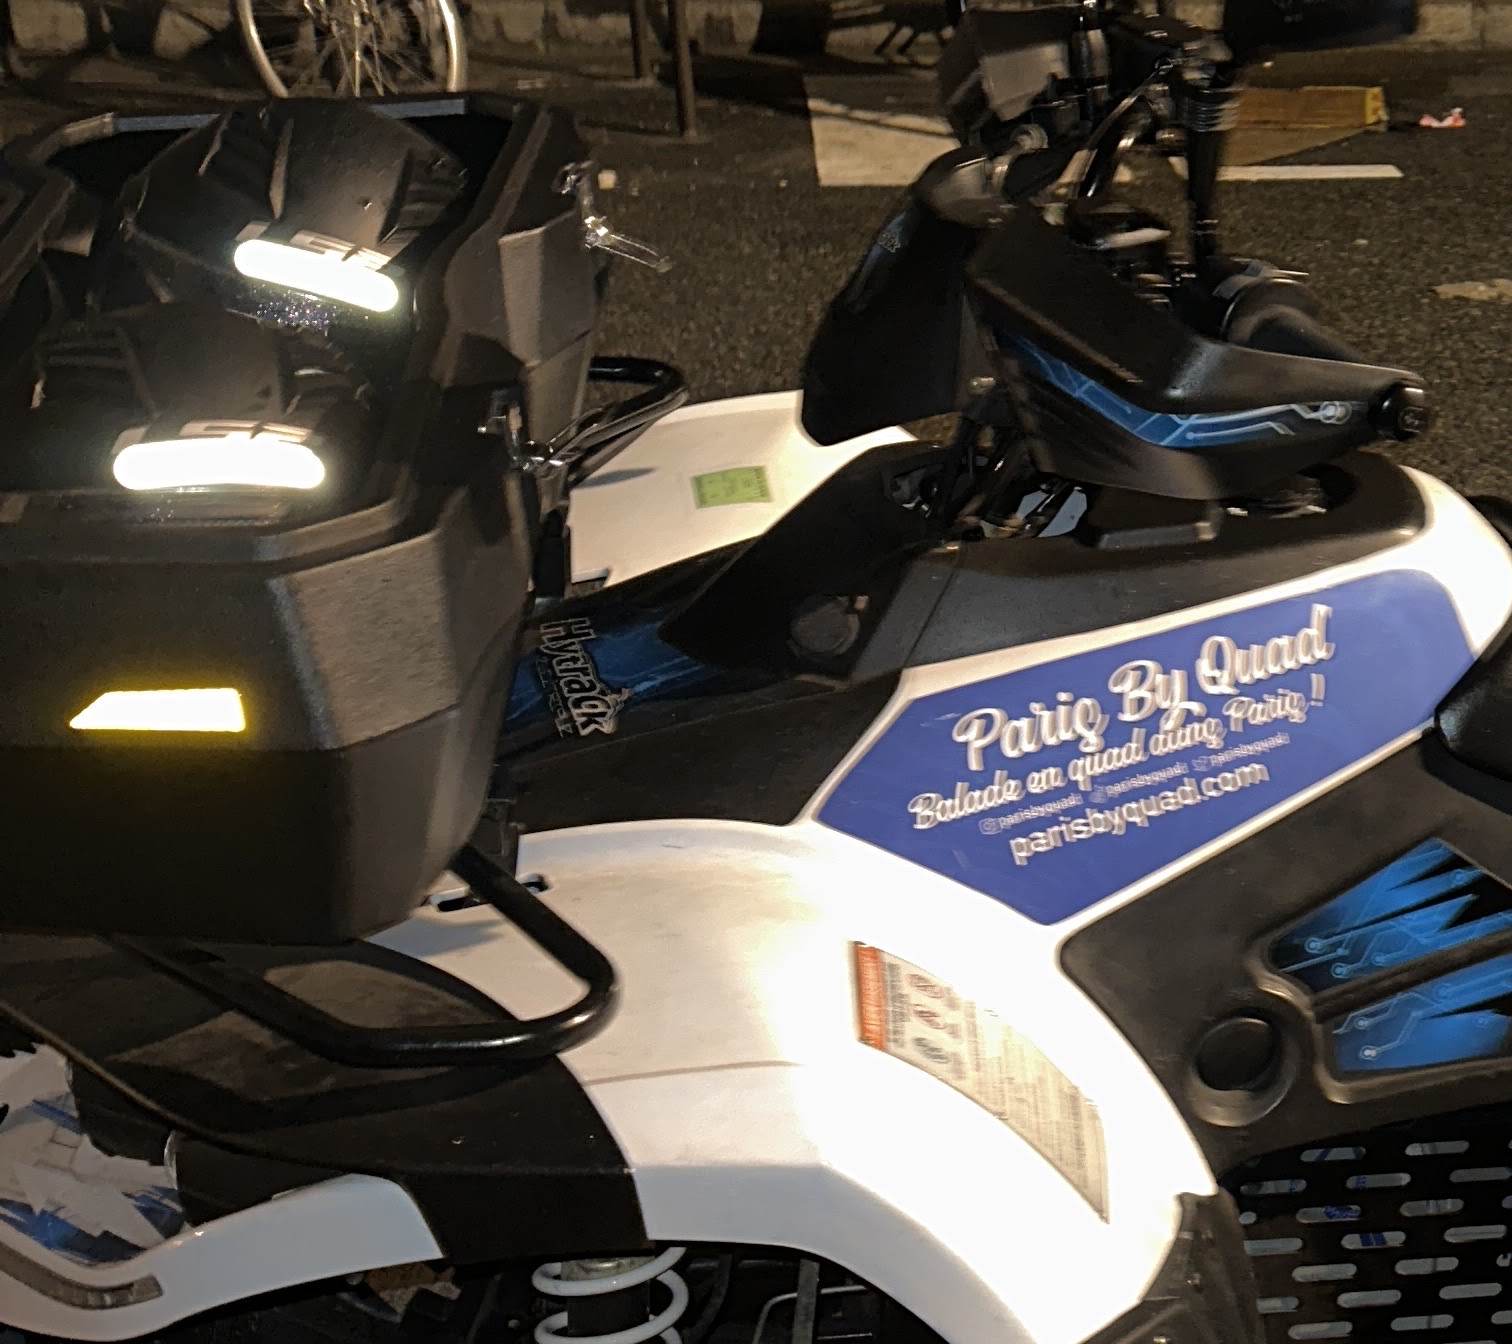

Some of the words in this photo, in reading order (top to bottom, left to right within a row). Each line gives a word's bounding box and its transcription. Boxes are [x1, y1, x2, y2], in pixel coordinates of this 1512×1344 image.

[952, 692, 1109, 771] Paris
[1108, 660, 1206, 731] By
[1195, 603, 1336, 695] Quad
[907, 770, 1026, 829] Balade
[1026, 766, 1066, 794] en
[1068, 727, 1149, 792] quad
[1008, 763, 1270, 866] parisbyquad.com
